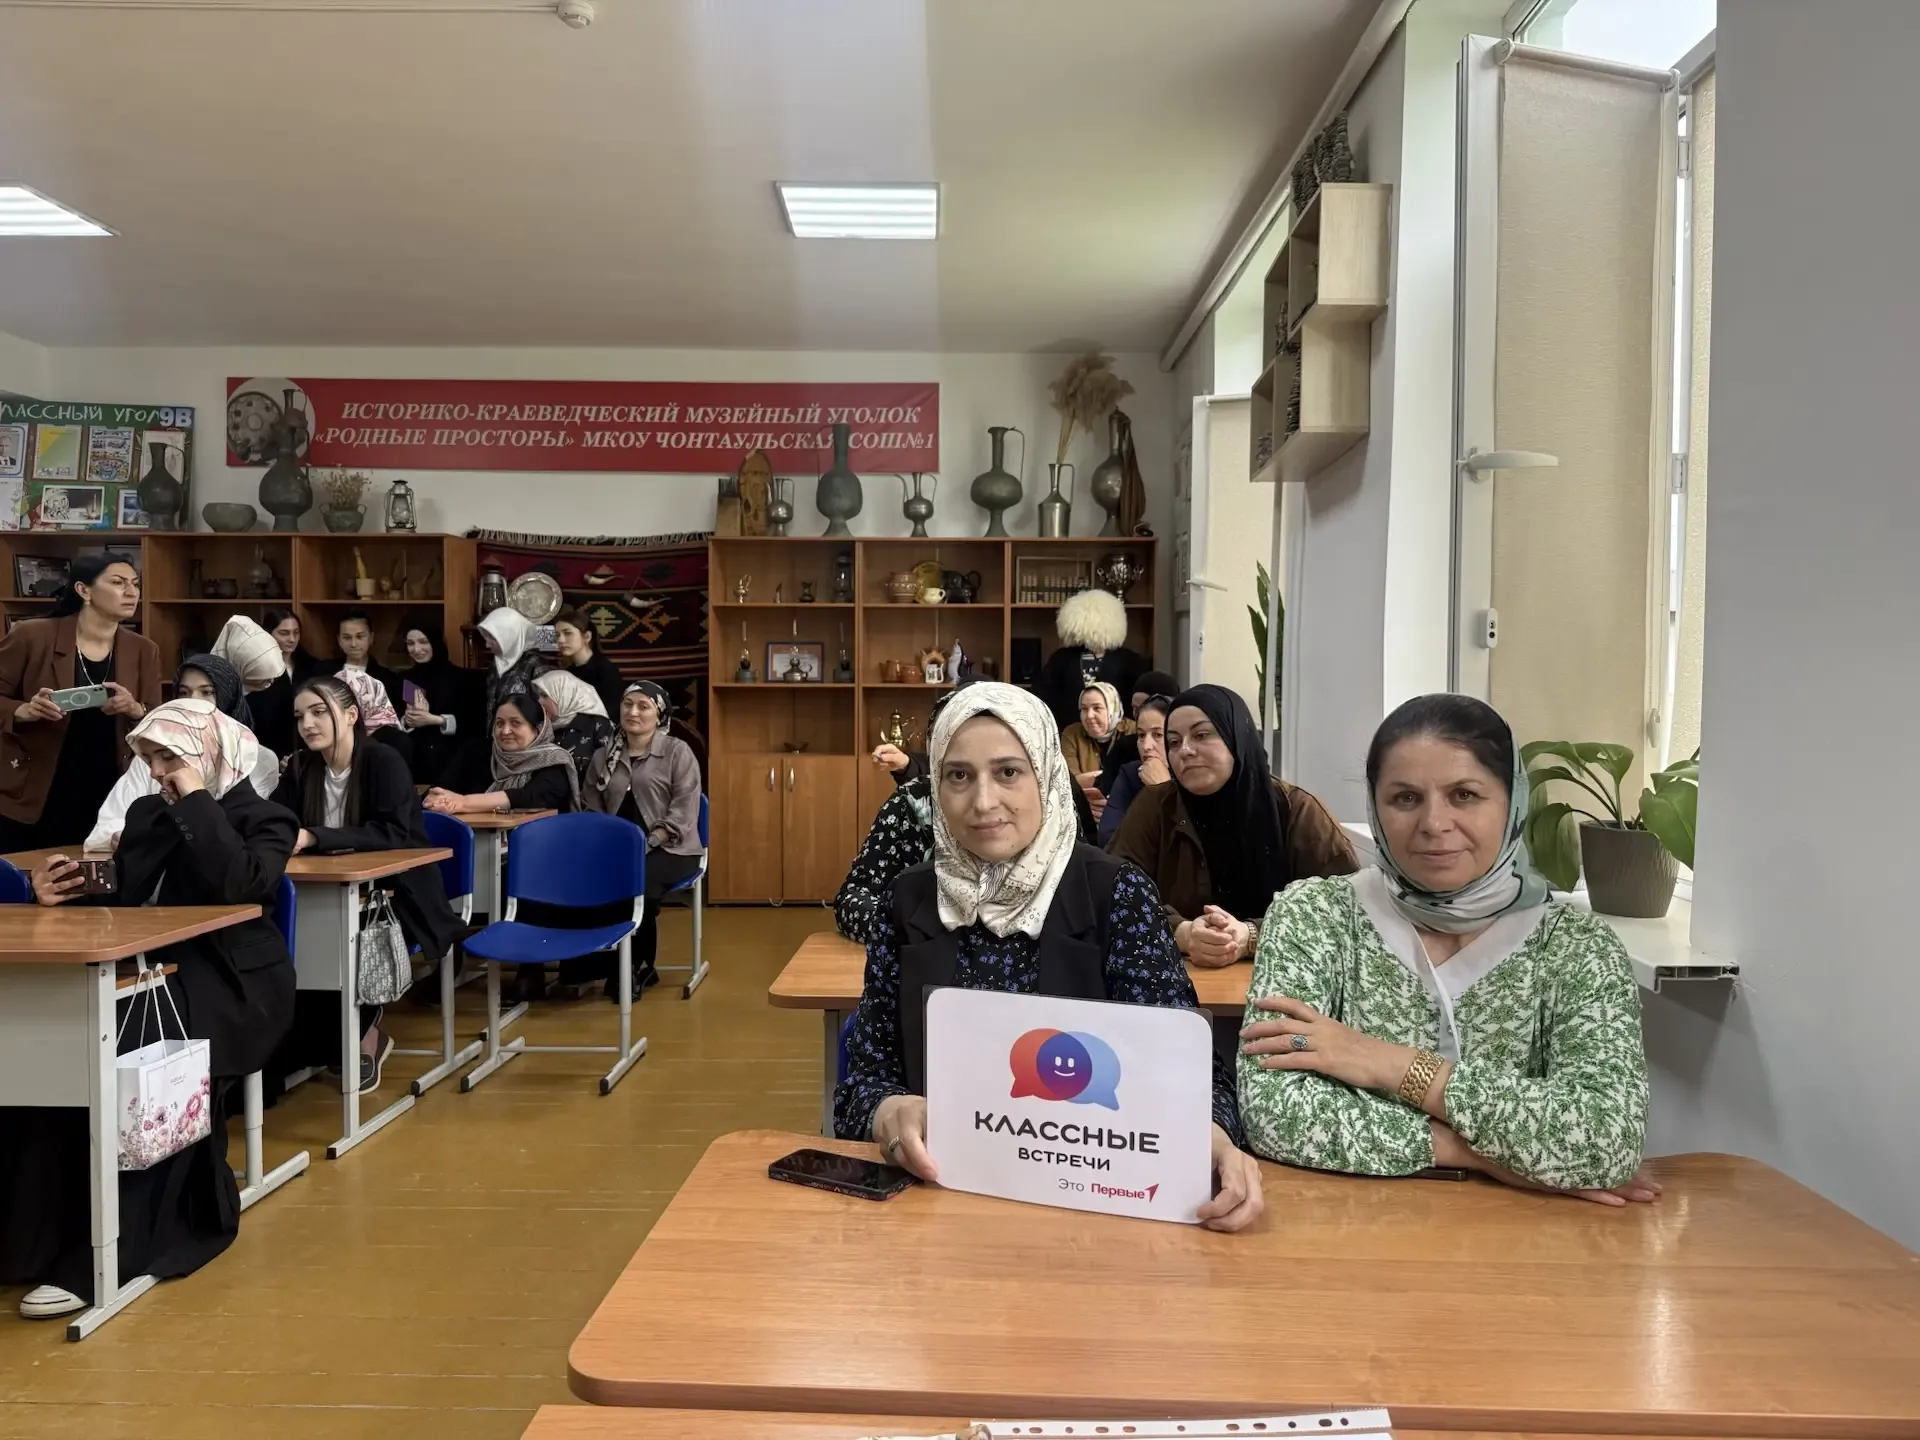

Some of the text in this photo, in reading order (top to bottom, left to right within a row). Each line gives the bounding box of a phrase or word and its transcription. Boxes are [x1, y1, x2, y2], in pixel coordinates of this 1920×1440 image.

[0, 401, 159, 424] ЛАССНЫЙ УГОЛ
[341, 402, 922, 426] ИСТОРИКО-КРАЕВЕДЧЕСКИЙ МУЗЕЙНЫЙ УГОЛОК
[315, 427, 427, 449] «РОДНЫЕ
[432, 428, 575, 448] ПРОСТОРЫ»
[580, 431, 652, 449] МКОУ
[974, 1110, 1160, 1155] КЛАССНЫЕ
[1018, 1147, 1111, 1171] ВСТРЕЧИ
[1058, 1178, 1146, 1200] Это Первые
